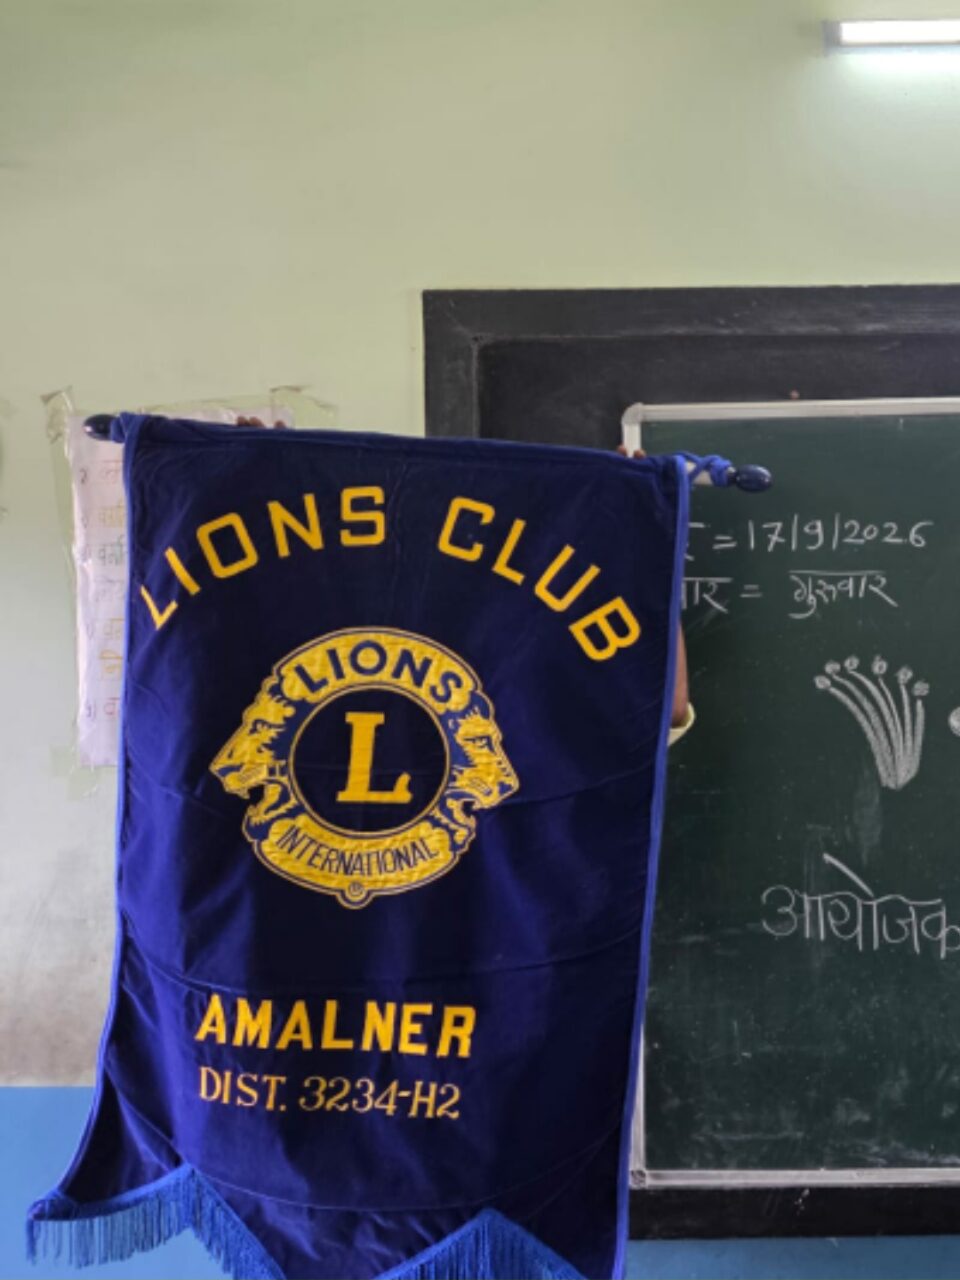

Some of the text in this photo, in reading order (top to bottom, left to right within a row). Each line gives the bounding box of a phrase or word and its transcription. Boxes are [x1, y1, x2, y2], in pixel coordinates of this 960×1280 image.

[140, 485, 386, 631] LIONS
[437, 496, 641, 662] CLUB
[294, 639, 463, 703] LIONS
[336, 711, 413, 804] L
[275, 823, 440, 877] INTERNATIONAL
[195, 993, 476, 1059] AMALNER
[199, 1066, 461, 1120] DIST. 3234-H2
